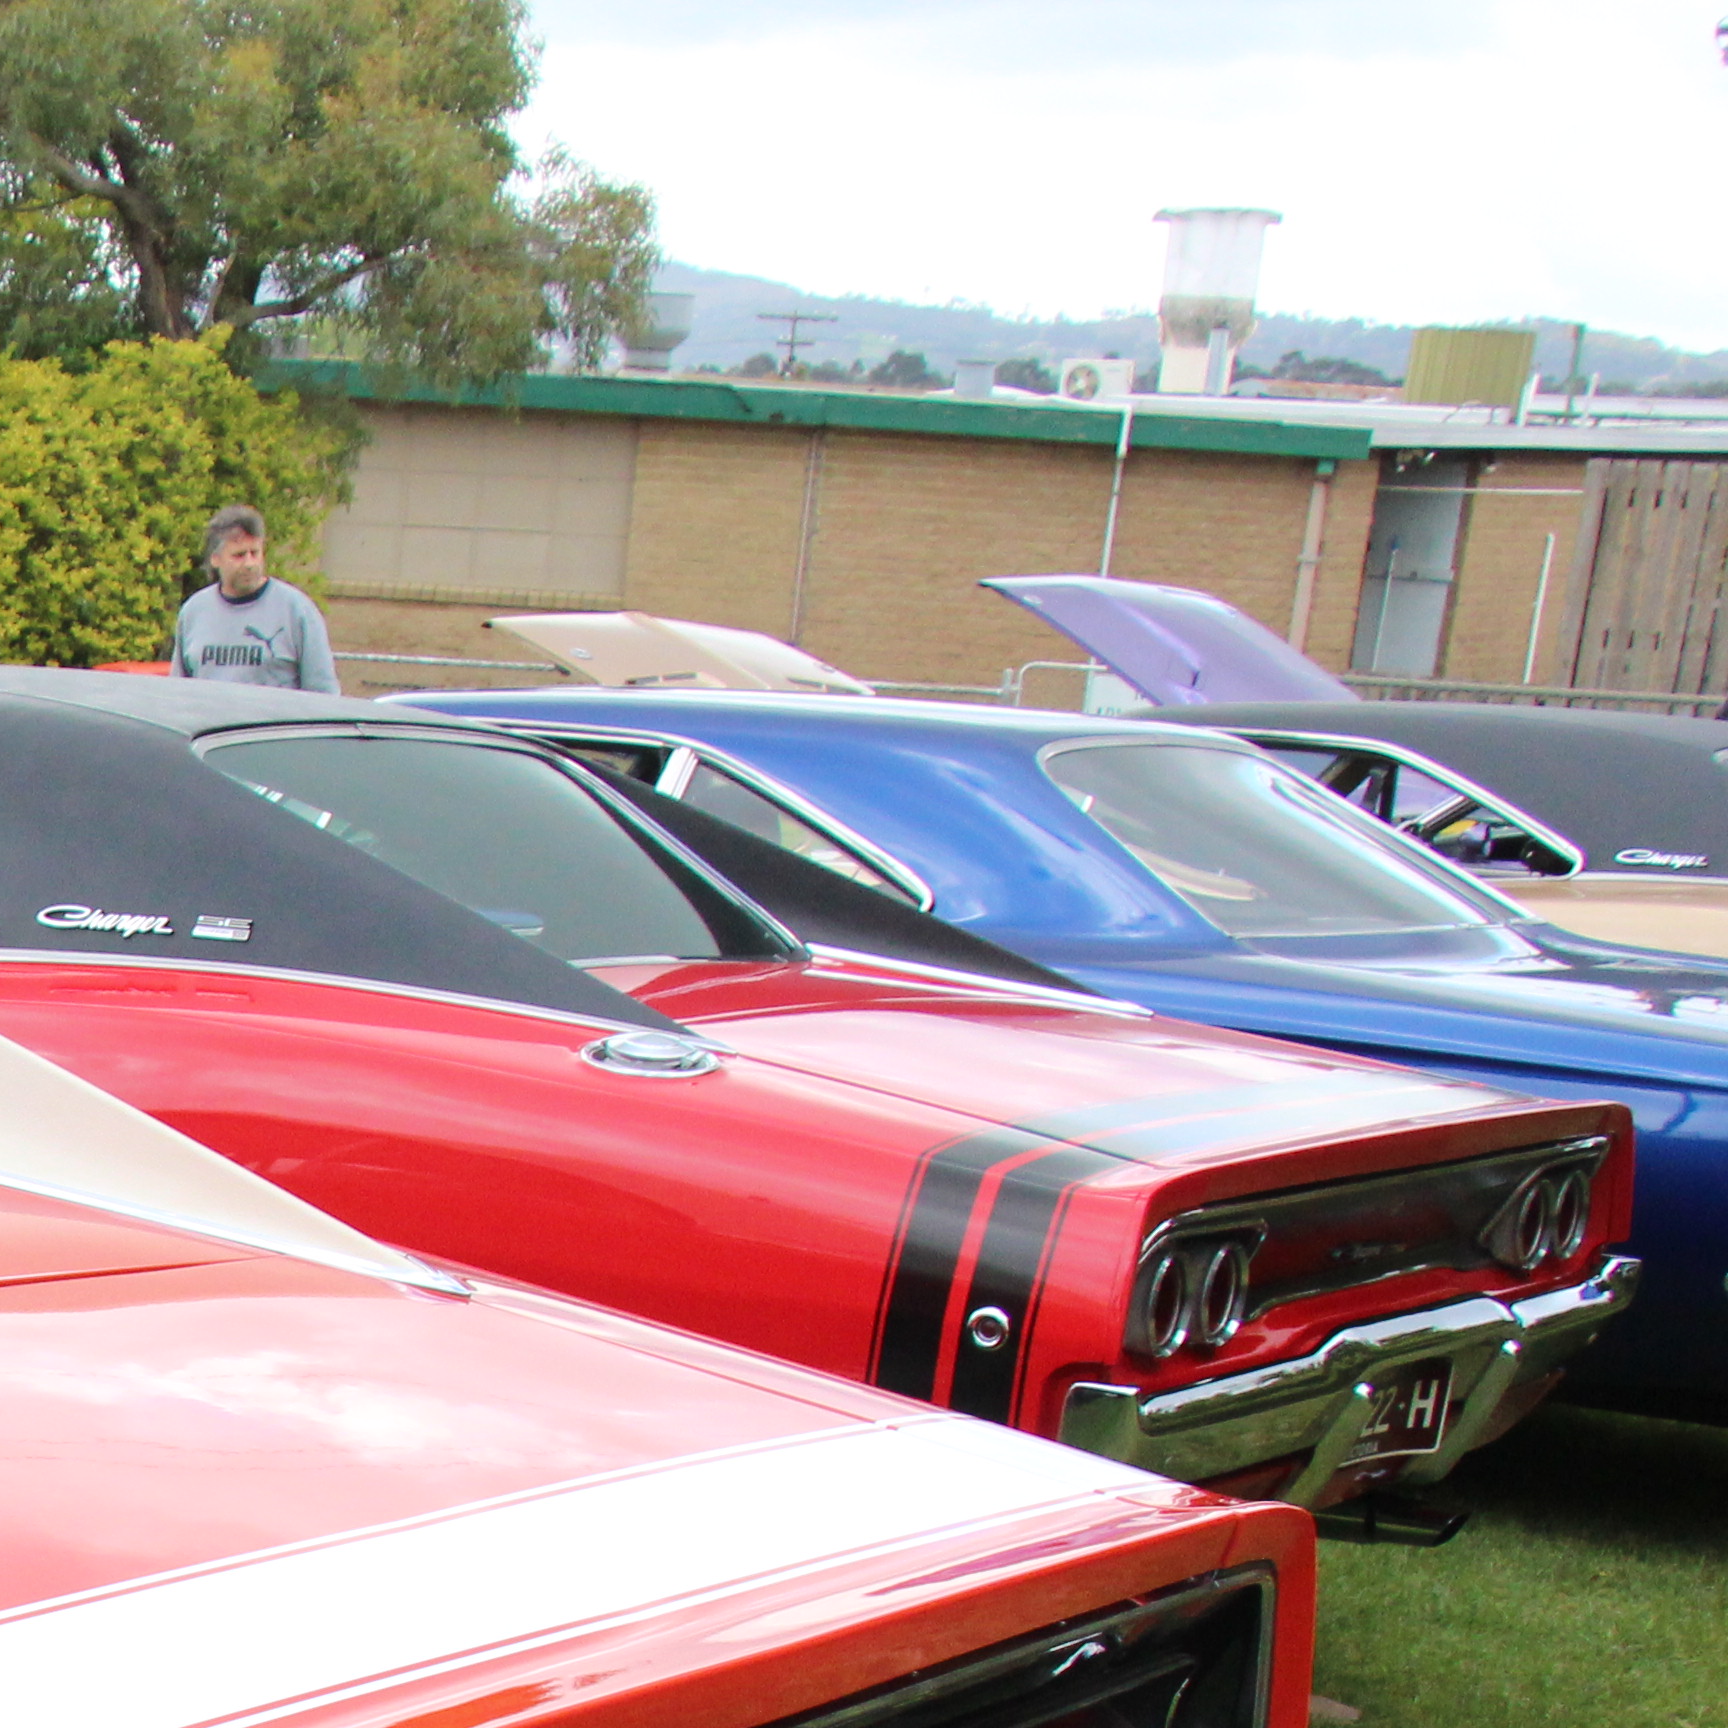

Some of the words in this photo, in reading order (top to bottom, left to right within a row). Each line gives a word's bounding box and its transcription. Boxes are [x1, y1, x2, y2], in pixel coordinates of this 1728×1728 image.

[201, 645, 262, 666] PUMA
[1613, 847, 1710, 871] Charger
[34, 903, 175, 939] Charger
